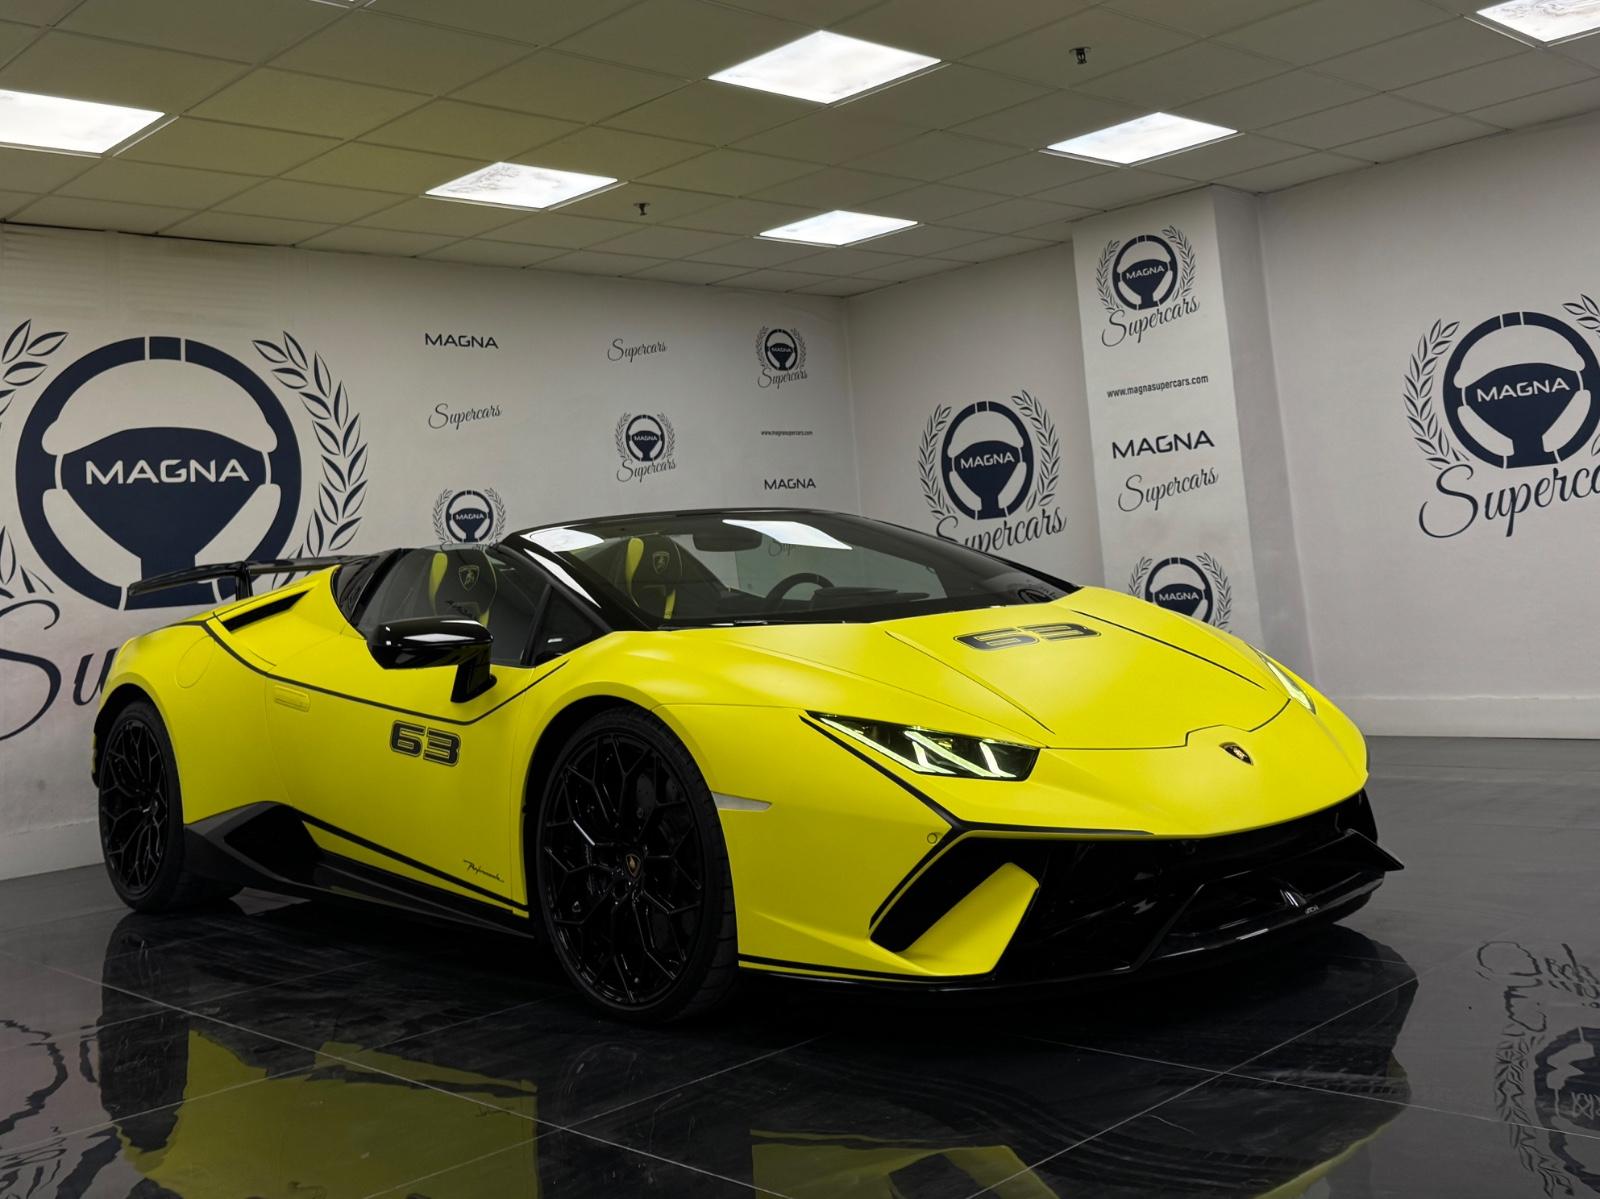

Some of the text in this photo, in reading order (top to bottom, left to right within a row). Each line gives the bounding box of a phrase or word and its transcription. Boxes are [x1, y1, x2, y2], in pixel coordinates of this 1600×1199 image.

[1126, 265, 1165, 280] MAGNA
[1101, 296, 1200, 347] Supercars
[424, 332, 499, 349] MAGNA
[607, 338, 668, 362] Supercars
[757, 367, 807, 390] Supercars
[1106, 375, 1209, 398] www.magnasupercars.com
[1477, 377, 1570, 402] MAGNA
[428, 402, 502, 430] Supercars
[1111, 430, 1215, 459] MAGNA
[85, 458, 250, 485] MAGNA
[616, 459, 677, 483] Supercars
[960, 452, 1015, 469] MAGNA
[764, 478, 816, 490] MAGNA
[1117, 467, 1219, 512] Supercars
[455, 512, 485, 521] MAGNA
[1158, 591, 1200, 602] MAGNA
[953, 622, 1102, 651] 63
[390, 719, 461, 768] 63
